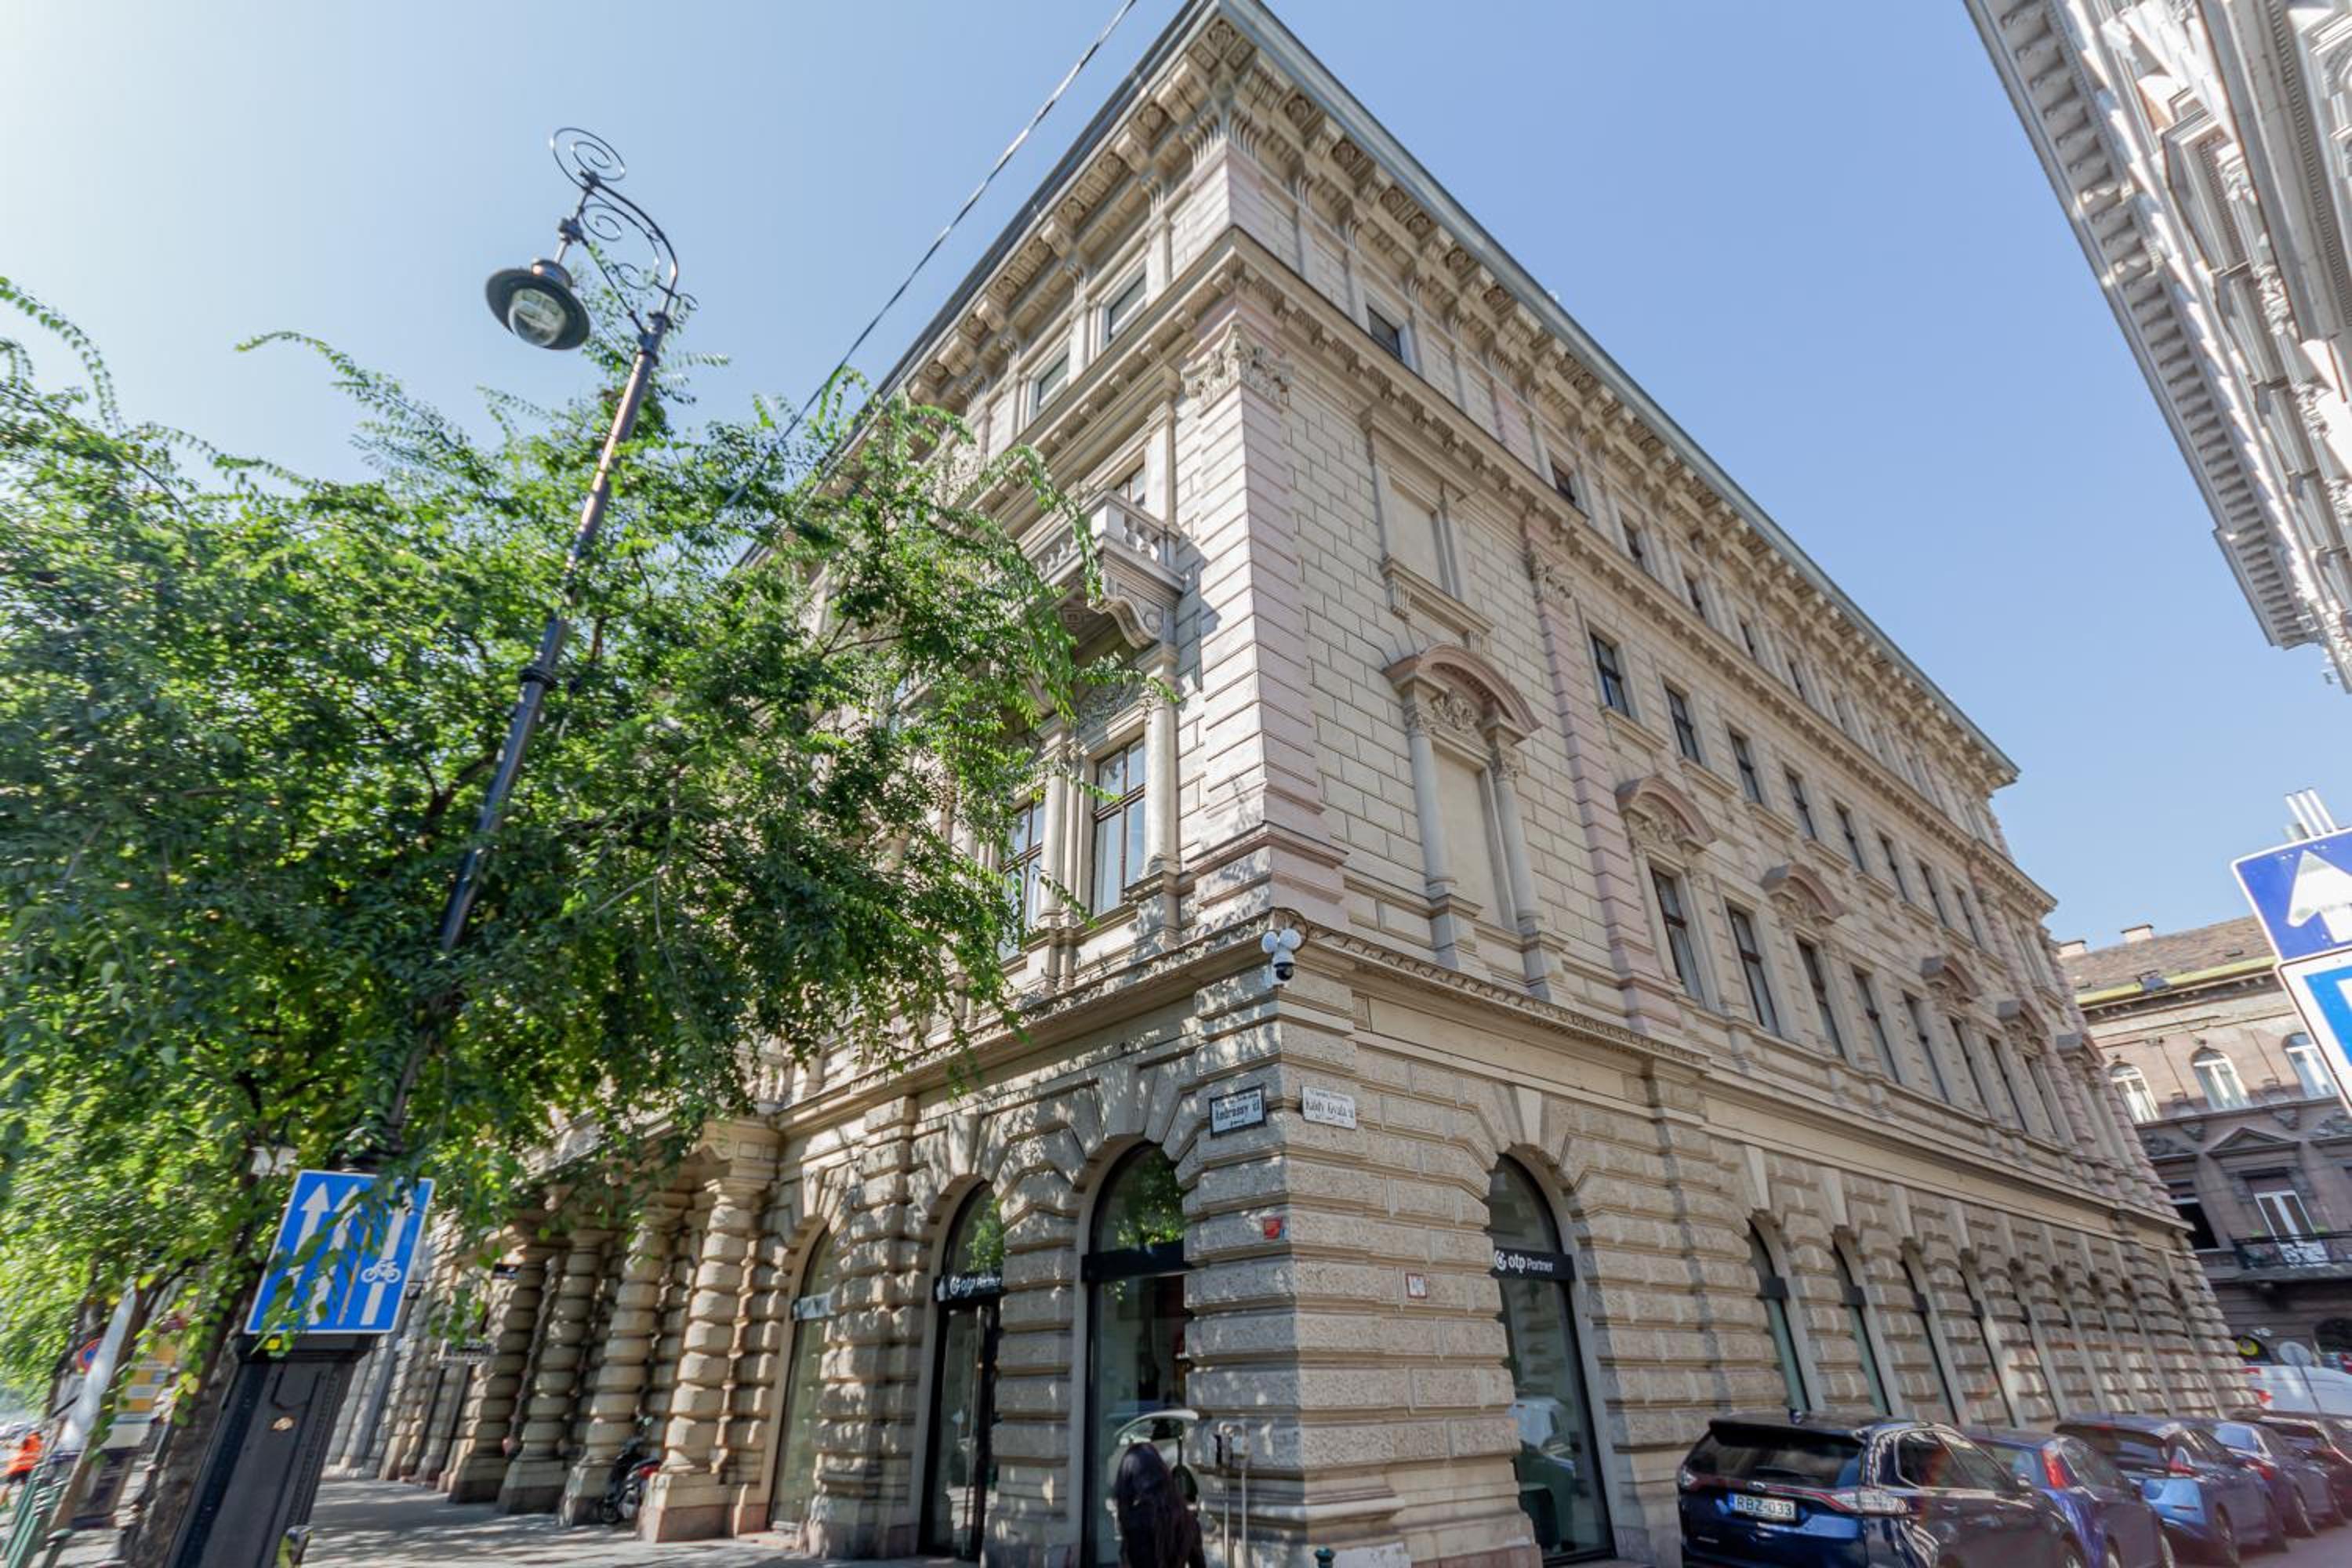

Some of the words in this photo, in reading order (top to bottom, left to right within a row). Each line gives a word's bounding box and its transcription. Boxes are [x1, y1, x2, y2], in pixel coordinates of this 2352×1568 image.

[1508, 1254, 1526, 1274] otp
[1526, 1257, 1553, 1272] Partner
[1737, 1496, 1792, 1516] RBZ-033
